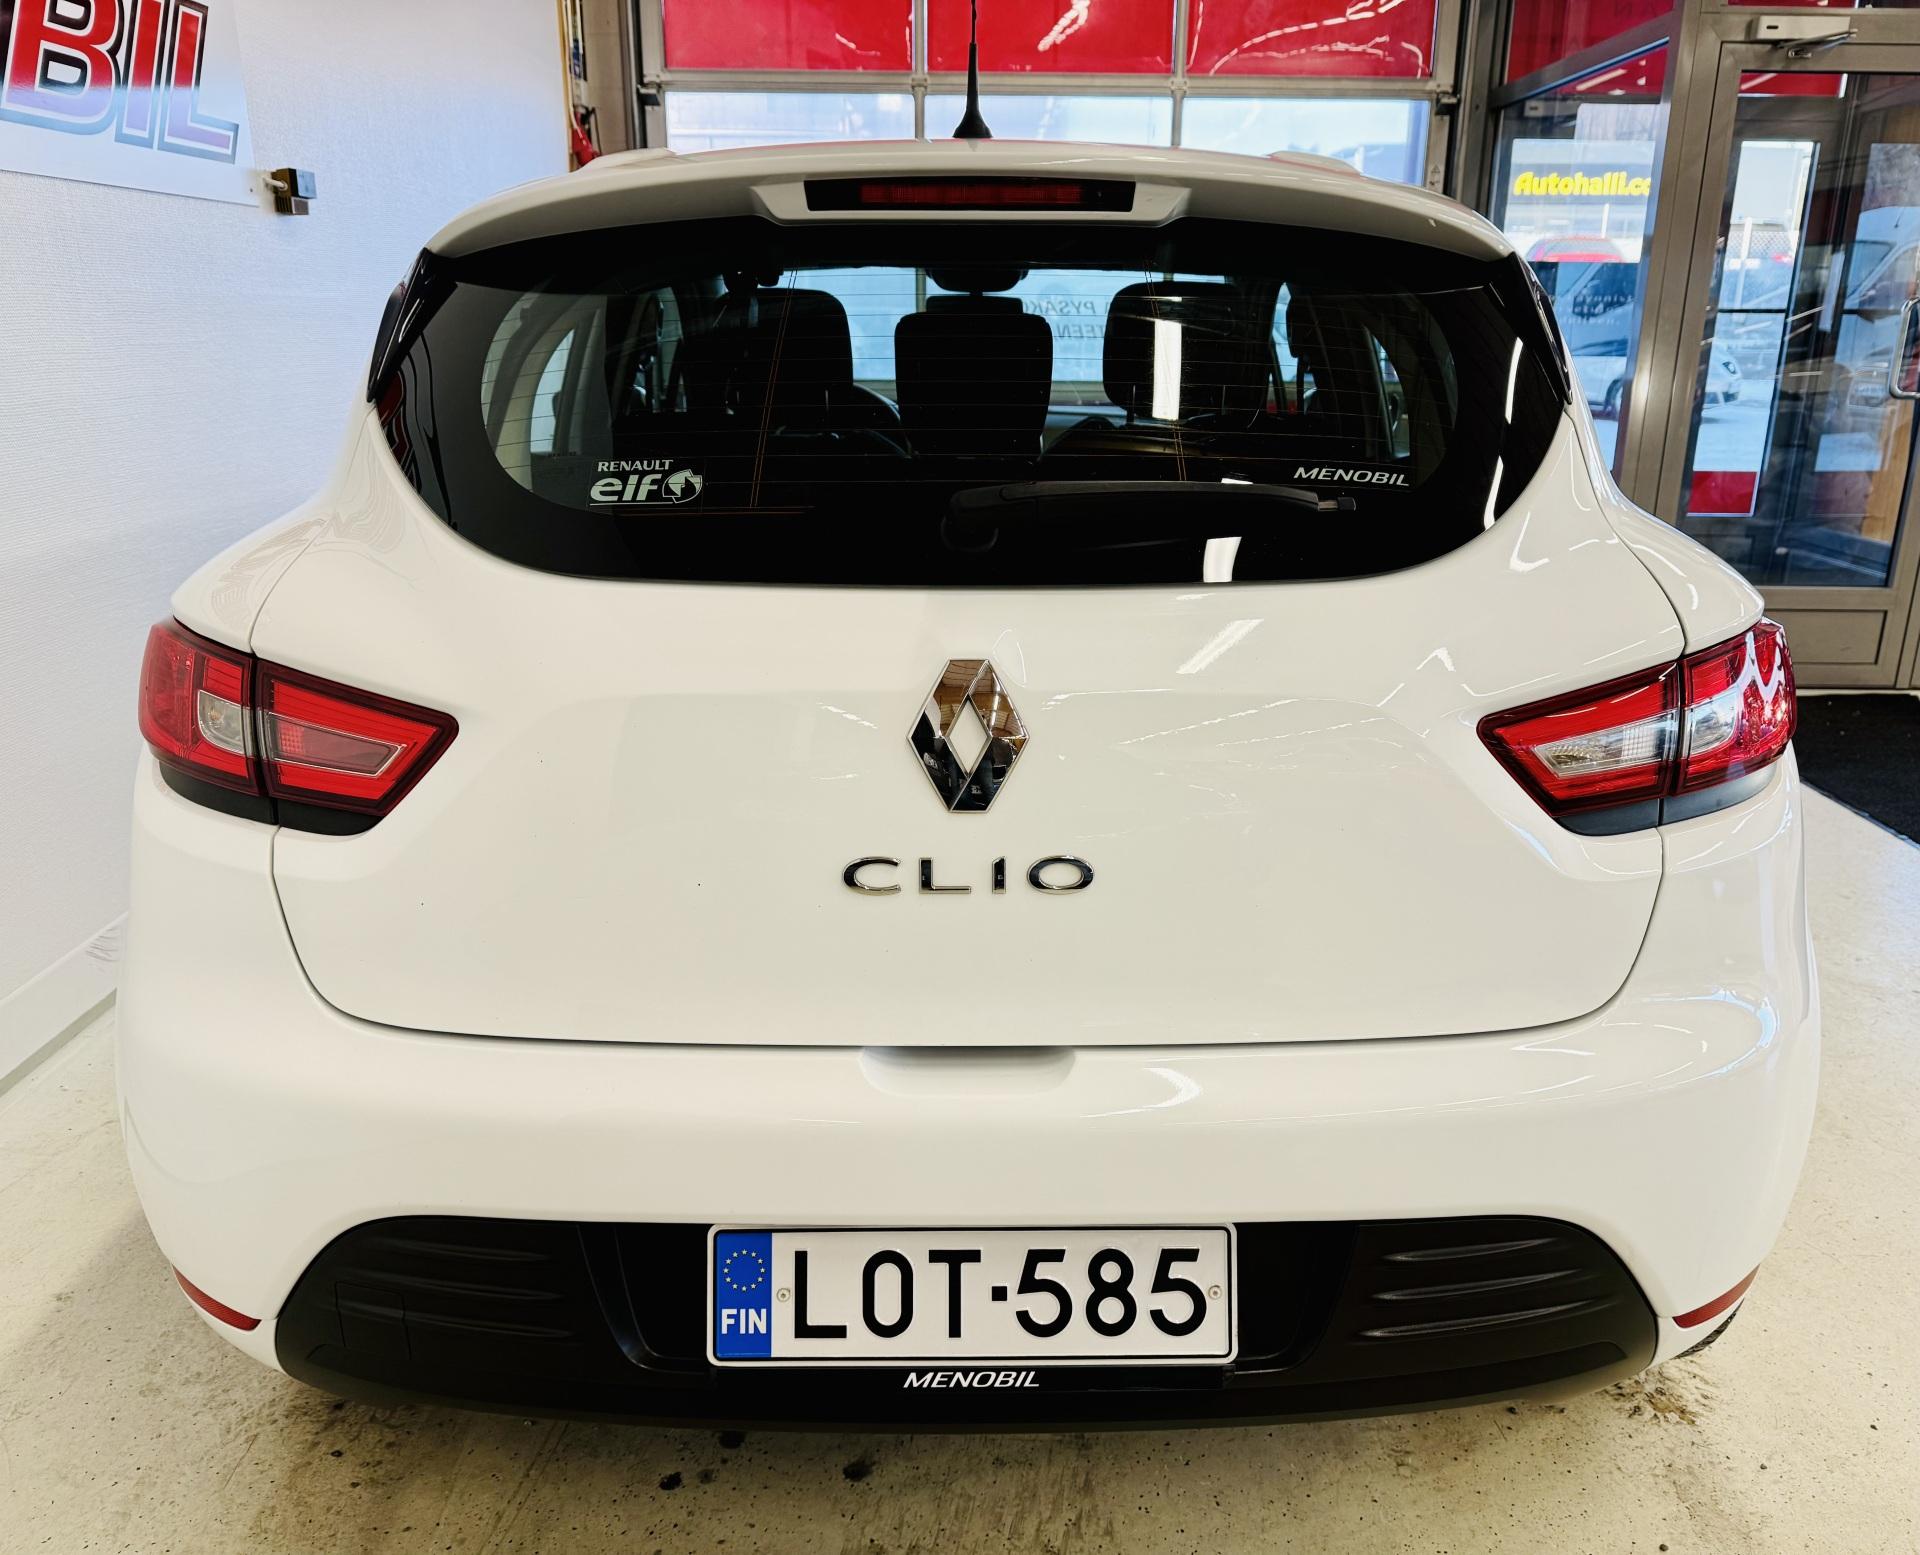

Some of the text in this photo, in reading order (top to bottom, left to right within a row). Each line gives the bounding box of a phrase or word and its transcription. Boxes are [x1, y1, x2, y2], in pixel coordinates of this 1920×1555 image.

[597, 459, 674, 472] RENAULT
[1293, 466, 1410, 487] MENOBIL
[590, 474, 662, 501] elf
[842, 855, 1094, 895] CLIO
[794, 1248, 1208, 1338] LOT-585
[721, 1308, 767, 1335] FIN
[903, 1371, 1040, 1388] MENOBIL
